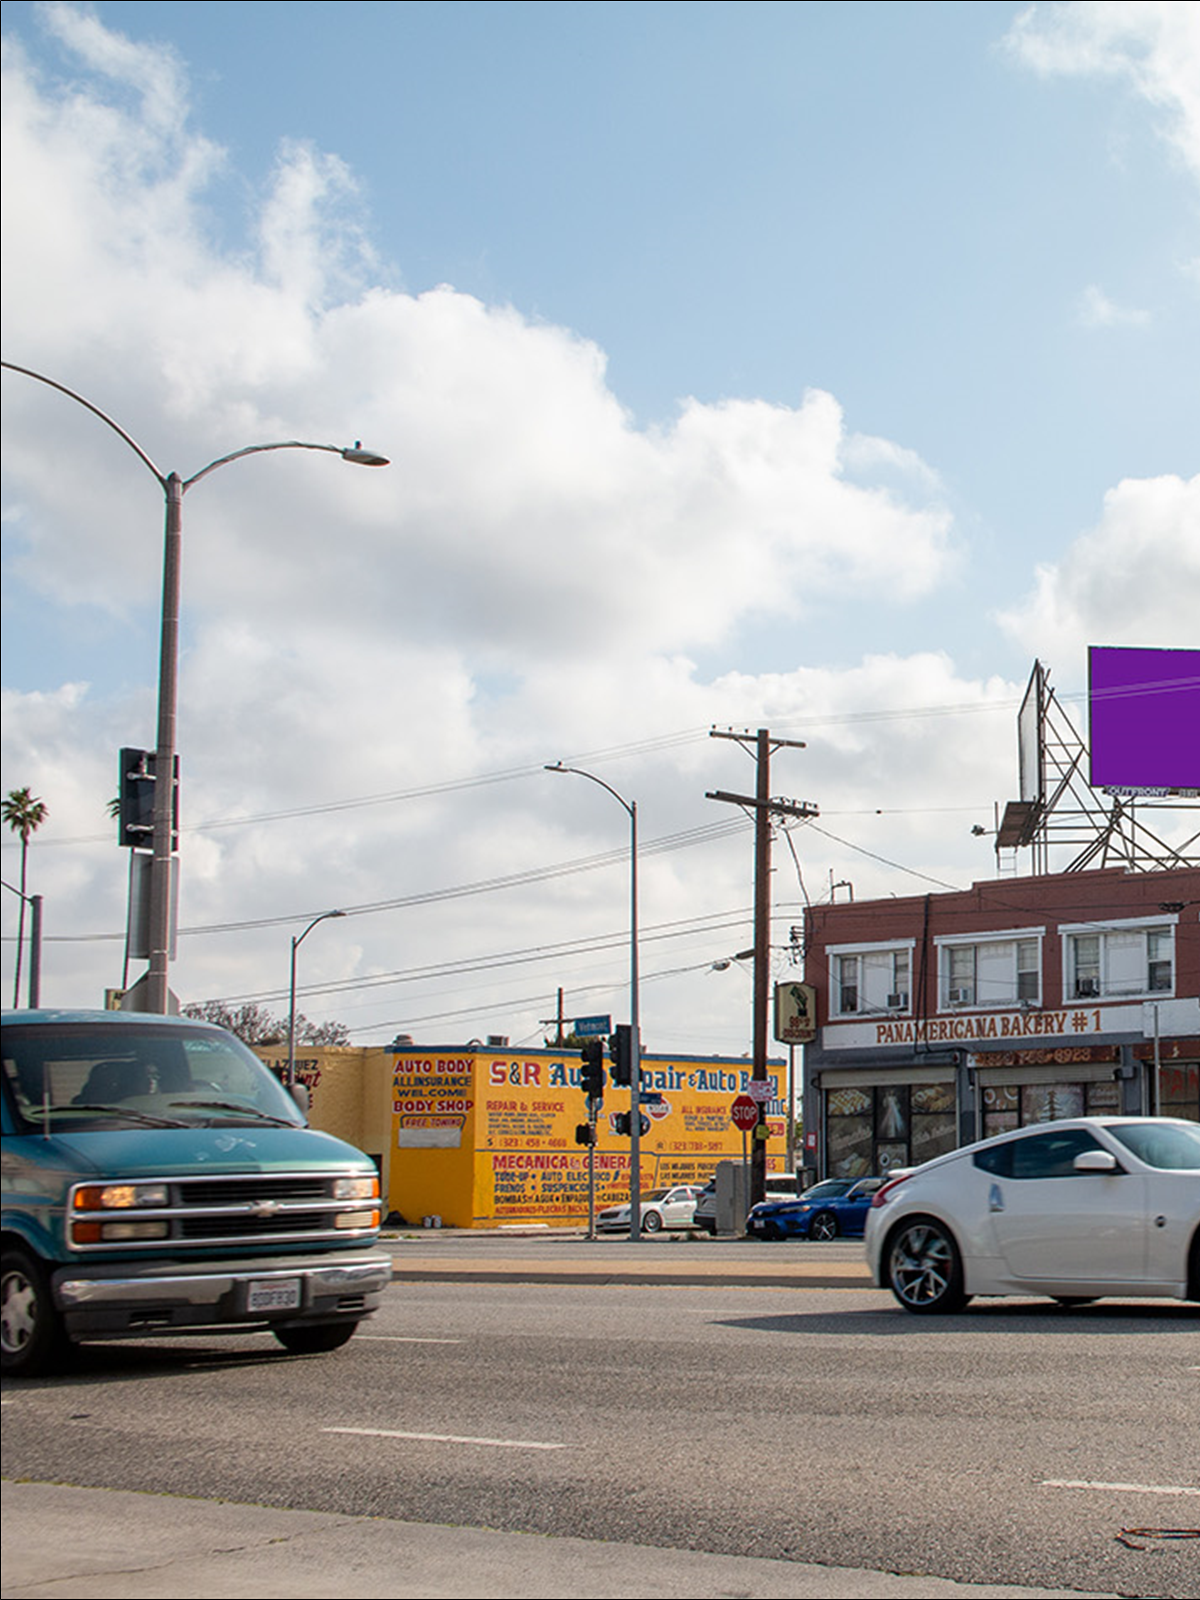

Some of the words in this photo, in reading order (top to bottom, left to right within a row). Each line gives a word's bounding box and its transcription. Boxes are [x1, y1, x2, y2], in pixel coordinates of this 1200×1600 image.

[876, 1017, 998, 1044] PANAMERICANA
[1000, 1012, 1067, 1037] BAKERY
[1072, 1015, 1087, 1032] #
[1091, 1010, 1102, 1032] 1
[394, 1060, 432, 1074] AUTO
[437, 1059, 474, 1073] BODY
[489, 1061, 541, 1087] S&R
[697, 1069, 737, 1092] Auto
[397, 1088, 467, 1098] WELCOME
[393, 1100, 433, 1113] BODY
[436, 1100, 474, 1113] SHOP
[486, 1100, 517, 1111] REPAIR
[532, 1102, 565, 1112] SERVICE
[681, 1105, 697, 1114] ALL
[733, 1106, 757, 1120] STOP
[405, 1117, 428, 1127] FREE
[430, 1117, 463, 1127] TOWING
[492, 1155, 569, 1170] MECANICA
[540, 1171, 564, 1182] AUTO
